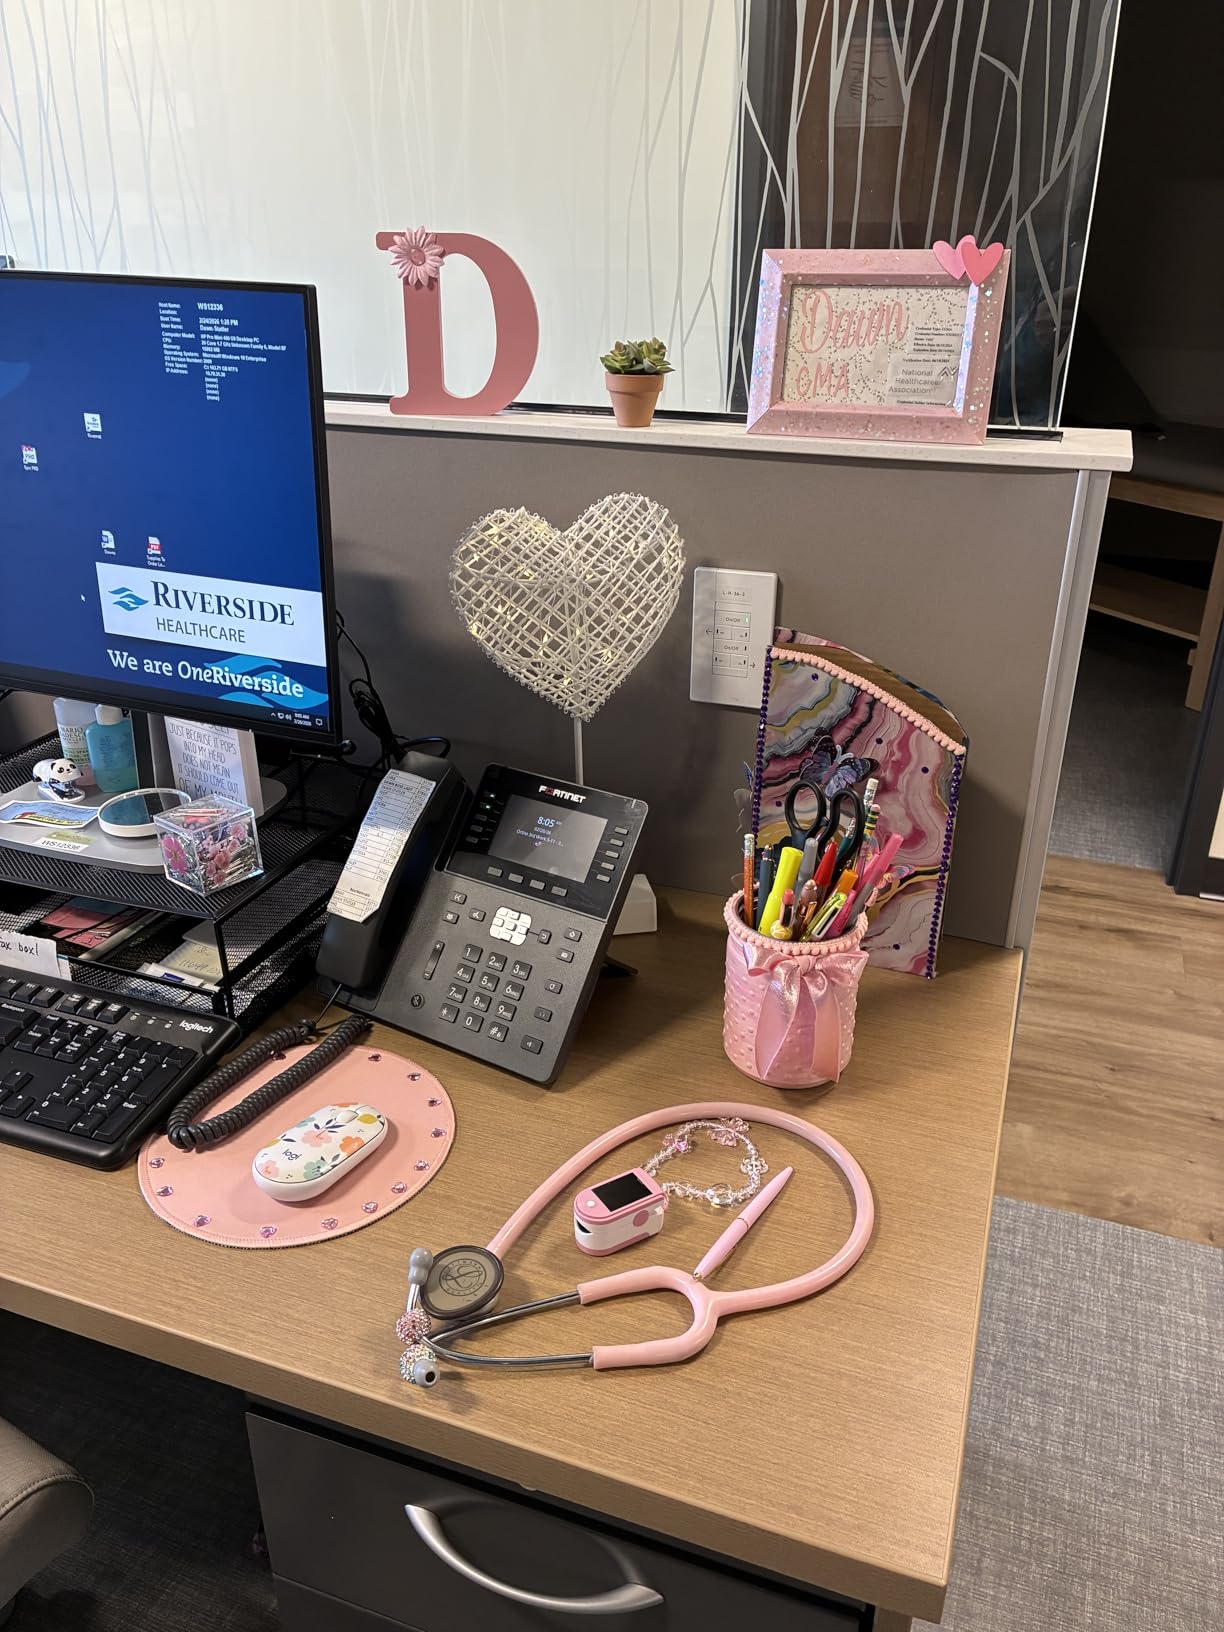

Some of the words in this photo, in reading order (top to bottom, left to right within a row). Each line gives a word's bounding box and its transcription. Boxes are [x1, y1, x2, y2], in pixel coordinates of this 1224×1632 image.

[376, 232, 539, 415] D
[800, 289, 910, 353] Dawn
[796, 361, 850, 398] CMA
[150, 580, 295, 626] RIVERSIDE
[156, 617, 246, 643] HEALTHCARE
[106, 649, 138, 670] We
[143, 658, 172, 676] are
[178, 661, 304, 698] OneRiverside
[170, 723, 183, 736] JUST
[186, 728, 212, 746] BECAUSE
[214, 738, 219, 748] IT
[220, 740, 236, 754] POPS
[184, 741, 196, 754] INTO
[198, 746, 207, 757] MY
[208, 750, 225, 763] HEAD
[183, 752, 198, 767] DOES
[200, 759, 210, 771] NOT
[213, 764, 230, 778] MEAN
[178, 764, 182, 772] IT
[185, 766, 208, 782] SHOULD
[210, 775, 224, 789] COME
[228, 782, 238, 794] OUT
[179, 777, 190, 792] OF
[195, 784, 206, 799] MY
[538, 785, 586, 803] FORTINET
[537, 816, 555, 827] 8:05
[42, 840, 80, 850] WS12336
[466, 948, 471, 956] 1
[488, 956, 496, 965] 2
[457, 968, 464, 976] 4
[513, 964, 519, 974] 3
[482, 976, 488, 984] 5
[449, 987, 456, 996] 7
[506, 985, 512, 993] 6
[474, 996, 480, 1005] 8
[498, 1005, 505, 1014] 9
[179, 1020, 214, 1034] logitech
[465, 1017, 472, 1026] 0
[282, 1149, 302, 1160] logi
